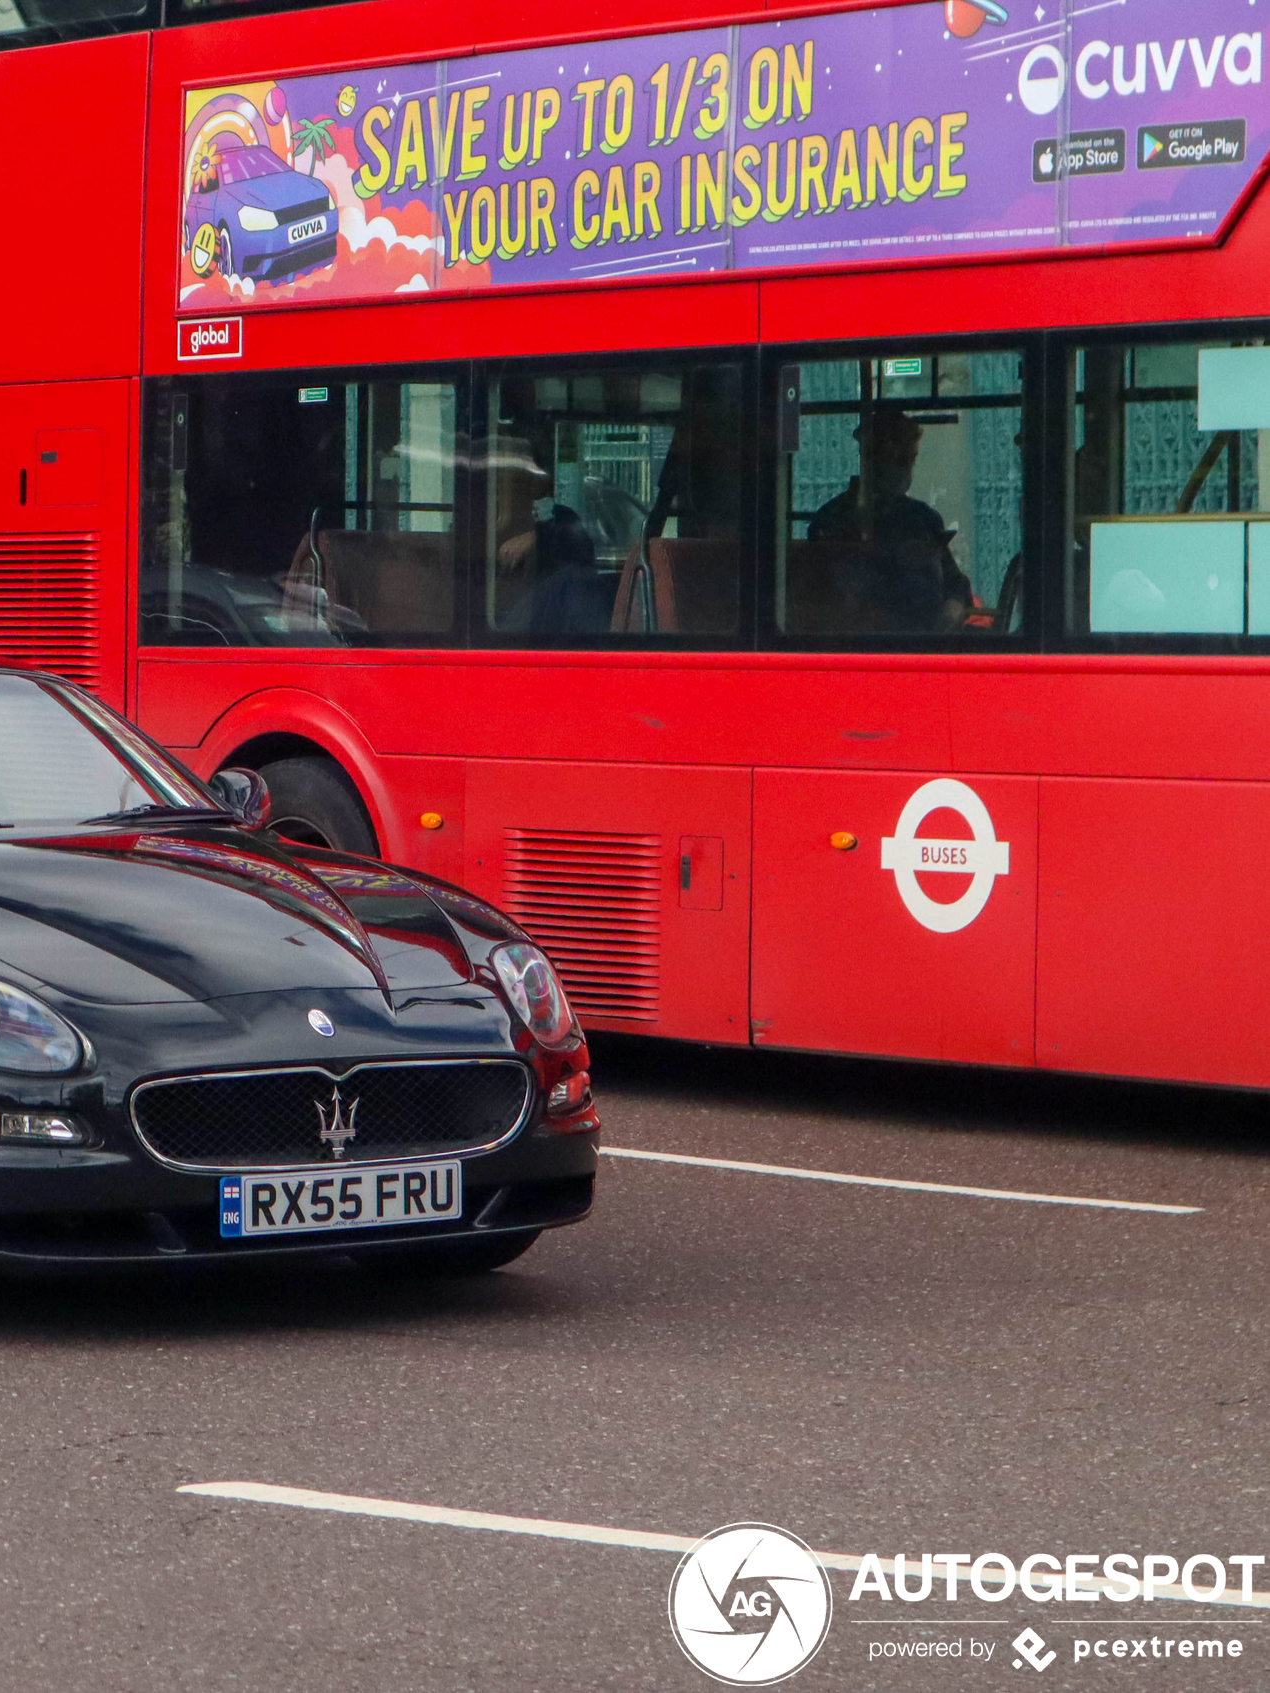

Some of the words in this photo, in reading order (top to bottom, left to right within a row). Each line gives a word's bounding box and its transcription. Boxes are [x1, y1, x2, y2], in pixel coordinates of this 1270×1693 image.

[1075, 31, 1262, 99] cuvva
[354, 85, 491, 199] SAVE
[499, 87, 561, 172] UP
[572, 73, 635, 159] TO
[645, 52, 730, 147] 1/3
[743, 40, 814, 130] ON
[1093, 139, 1103, 147] on
[1103, 137, 1115, 147] the
[1168, 128, 1182, 139] GET
[1182, 127, 1190, 138] IT
[1190, 127, 1202, 138] ON
[1058, 150, 1083, 170] App
[1085, 149, 1118, 166] Store
[1168, 139, 1212, 160] Google
[1214, 137, 1239, 157] Play
[443, 177, 556, 268] YOUR
[571, 160, 662, 250] CAR
[675, 112, 968, 235] INSURANCE
[291, 219, 323, 241] CUVVA
[190, 323, 229, 354] global
[921, 846, 967, 865] BUSES
[251, 1176, 363, 1227] RX55
[376, 1168, 453, 1218] FRU
[223, 1211, 239, 1224] ENG
